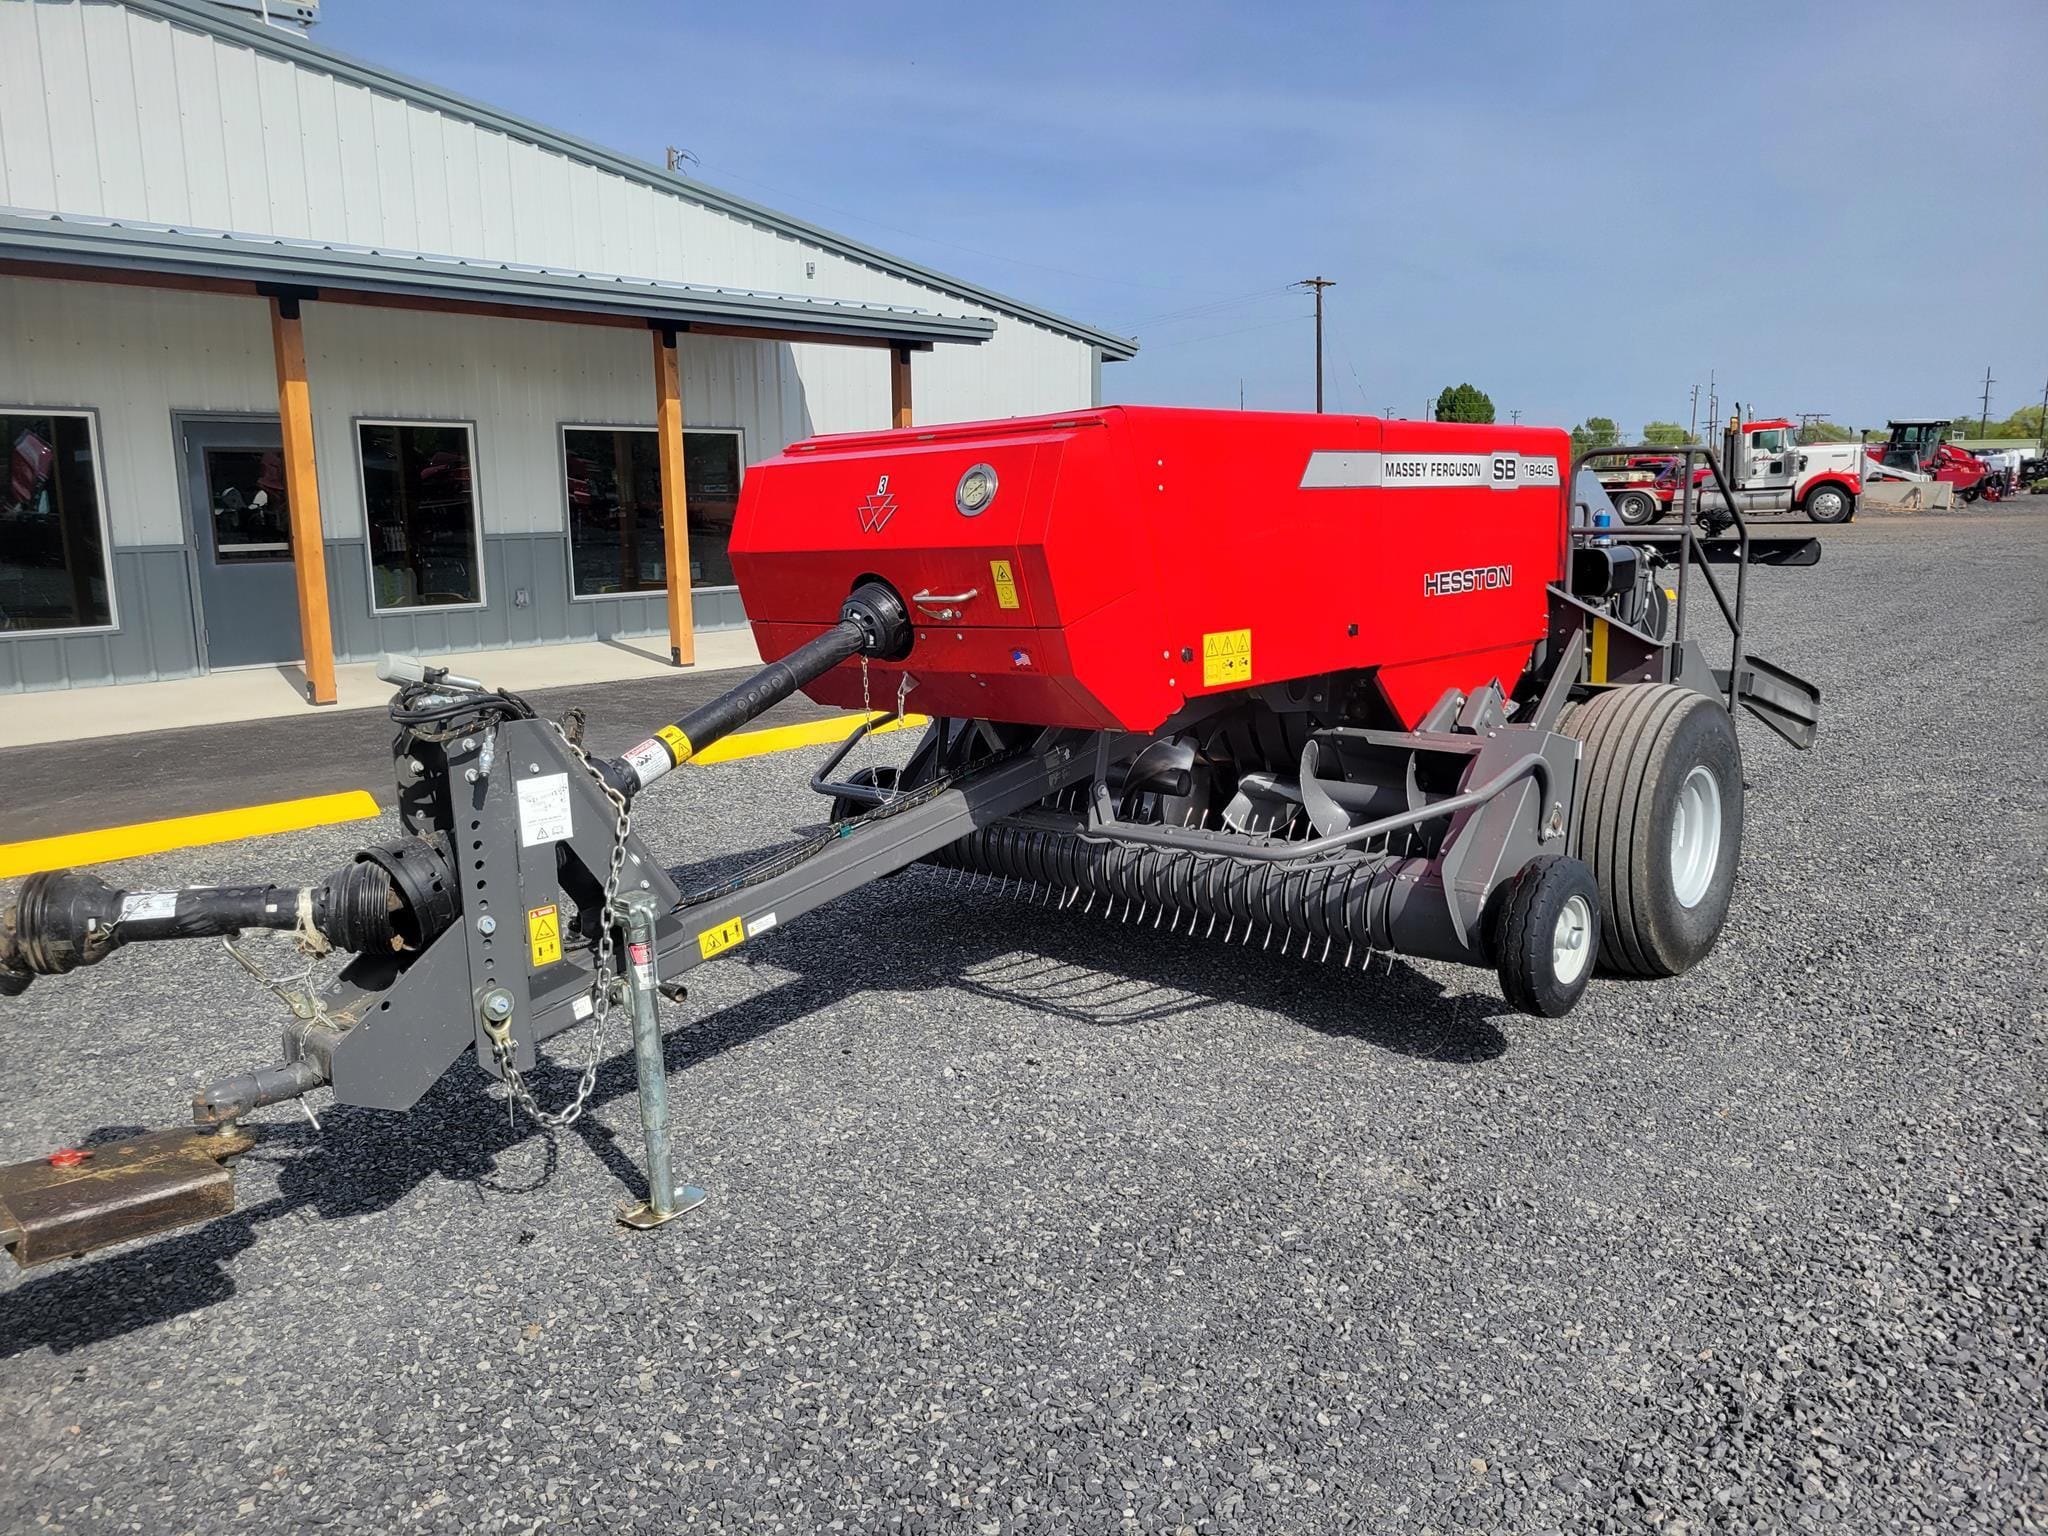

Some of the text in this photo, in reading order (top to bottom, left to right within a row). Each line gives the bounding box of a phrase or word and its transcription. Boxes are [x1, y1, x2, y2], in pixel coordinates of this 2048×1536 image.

[1385, 458, 1554, 481] MASSEY FERGUSON SB 1844S
[878, 477, 887, 494] 3
[1424, 565, 1512, 597] HESSTON
